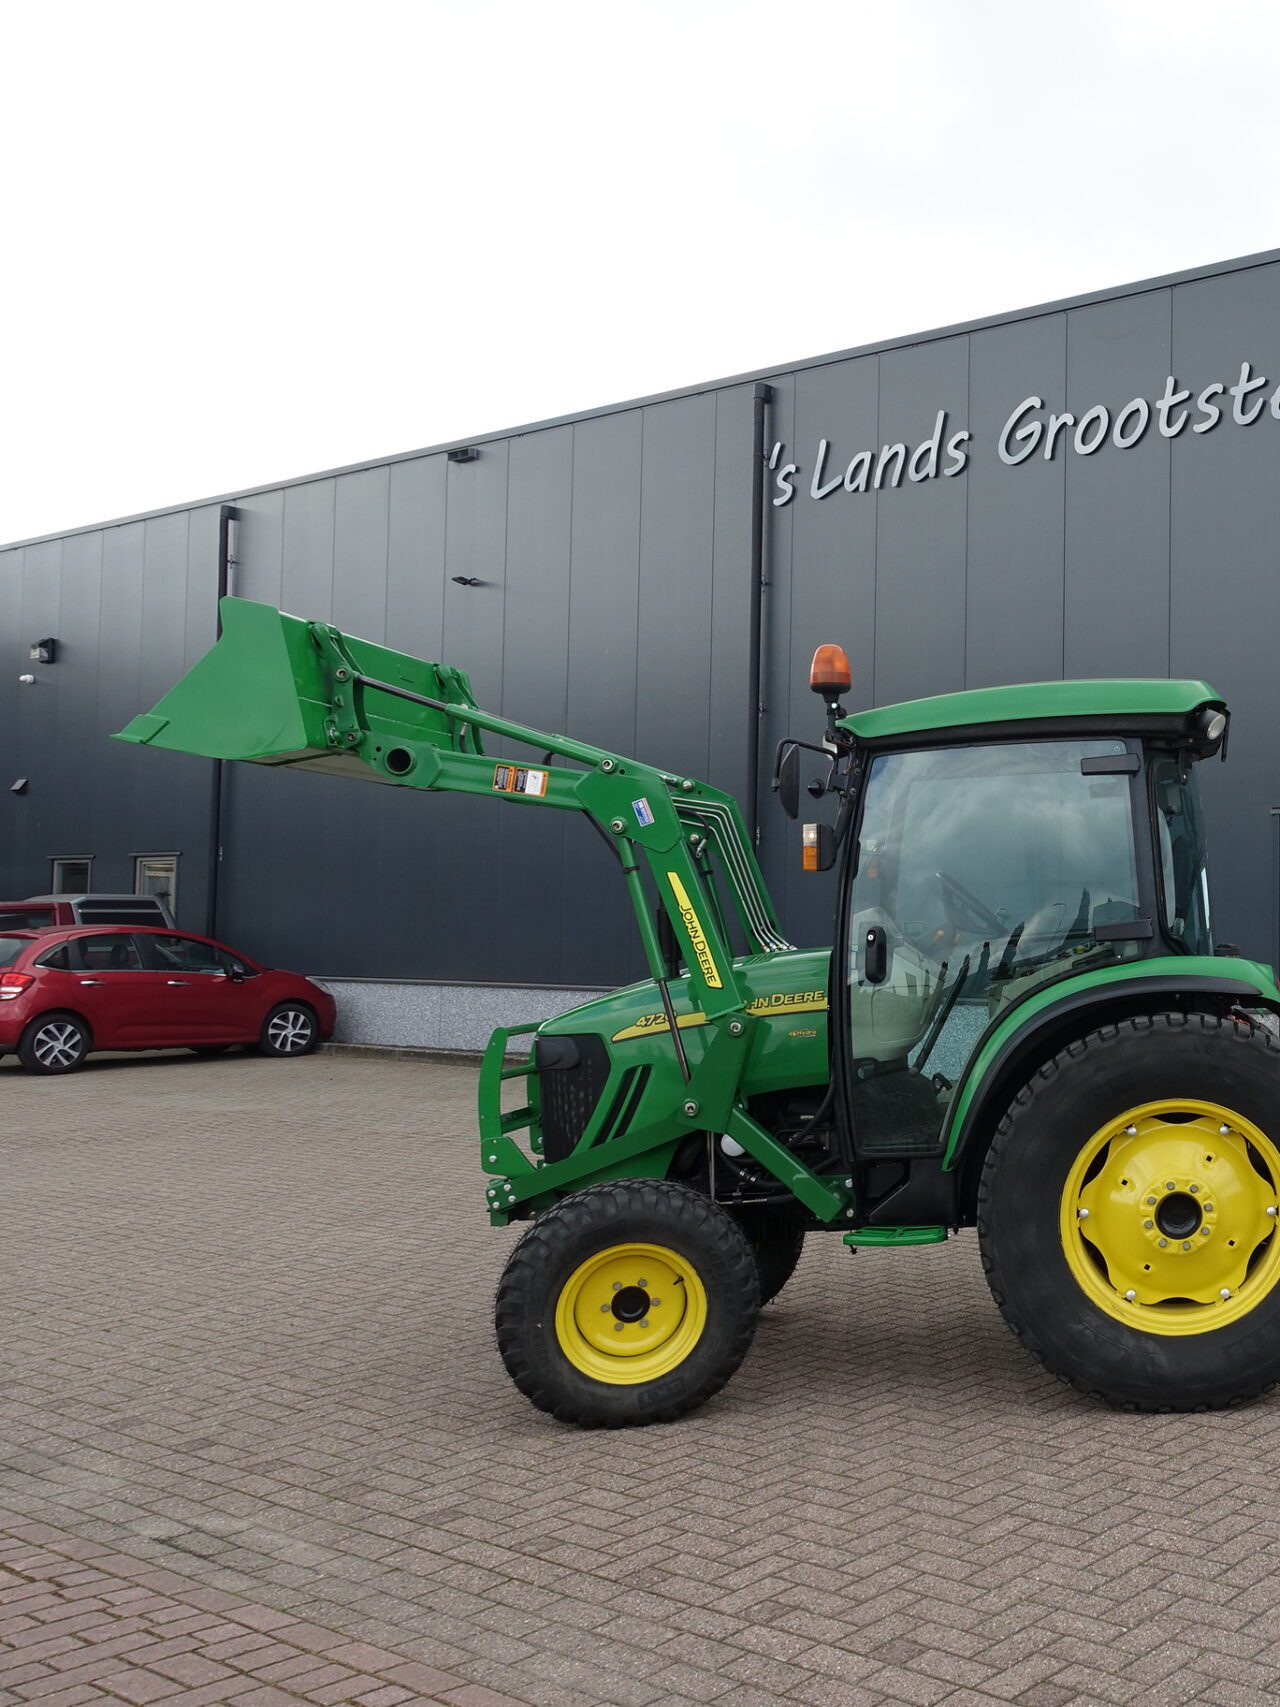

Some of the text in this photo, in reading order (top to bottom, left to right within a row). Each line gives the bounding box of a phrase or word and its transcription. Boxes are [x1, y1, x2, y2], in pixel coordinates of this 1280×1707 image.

[769, 442, 796, 506] 's
[810, 410, 969, 500] Lands
[680, 905, 717, 984] JOHN DEERE
[751, 990, 825, 1009] HN DEERE
